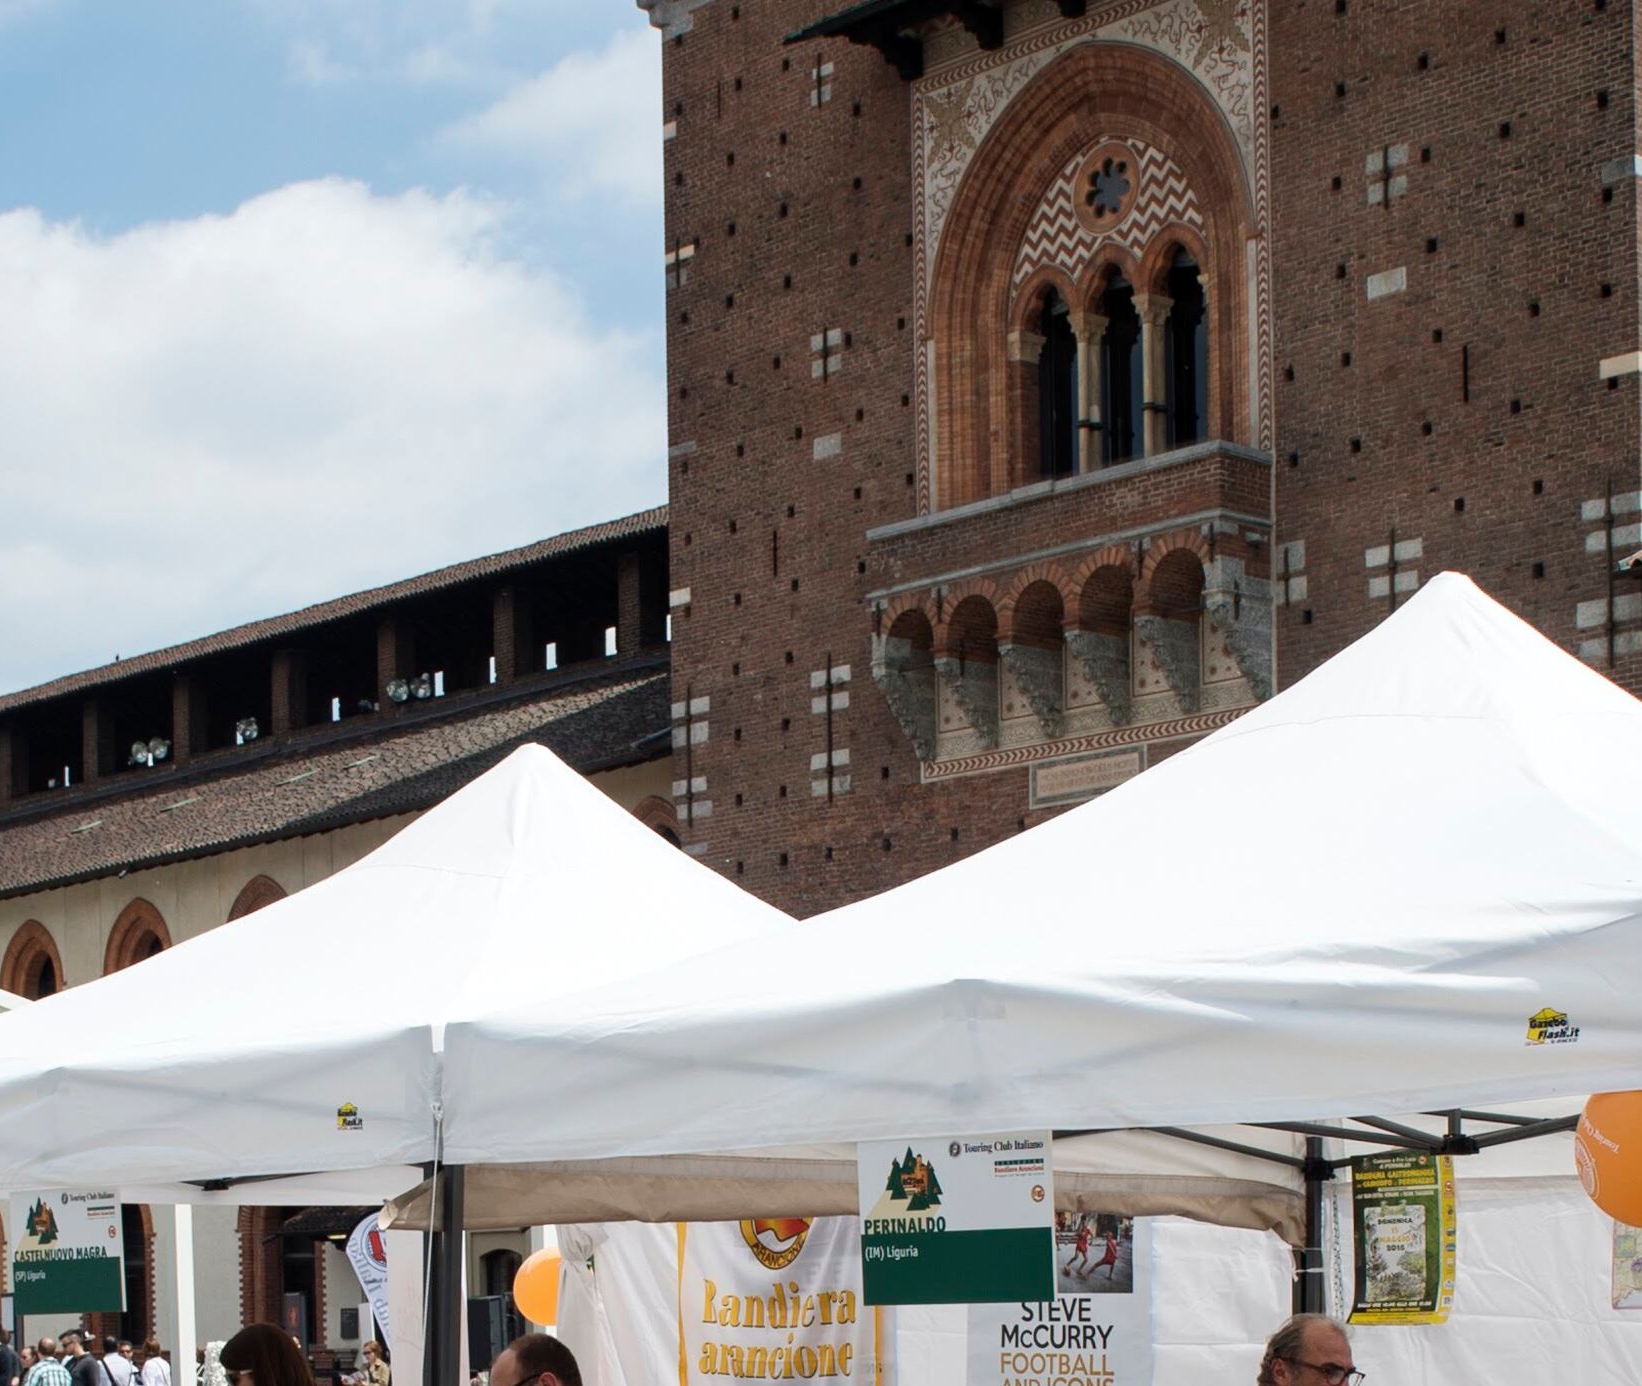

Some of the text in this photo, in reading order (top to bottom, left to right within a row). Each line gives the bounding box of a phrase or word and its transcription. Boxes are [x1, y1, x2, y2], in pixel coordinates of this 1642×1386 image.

[964, 1139, 1044, 1155] Touring Club Italiano
[864, 1216, 946, 1236] PERINALDO
[14, 1246, 108, 1263] CASTELNUOVO MAGRA
[865, 1245, 918, 1261] (IM) Liguria
[27, 1270, 46, 1282] Liguria
[1022, 1298, 1091, 1322] STEVE
[1001, 1325, 1114, 1349] McCURRY
[698, 1332, 854, 1380] arancione
[1000, 1352, 1115, 1376] FOOTBALL
